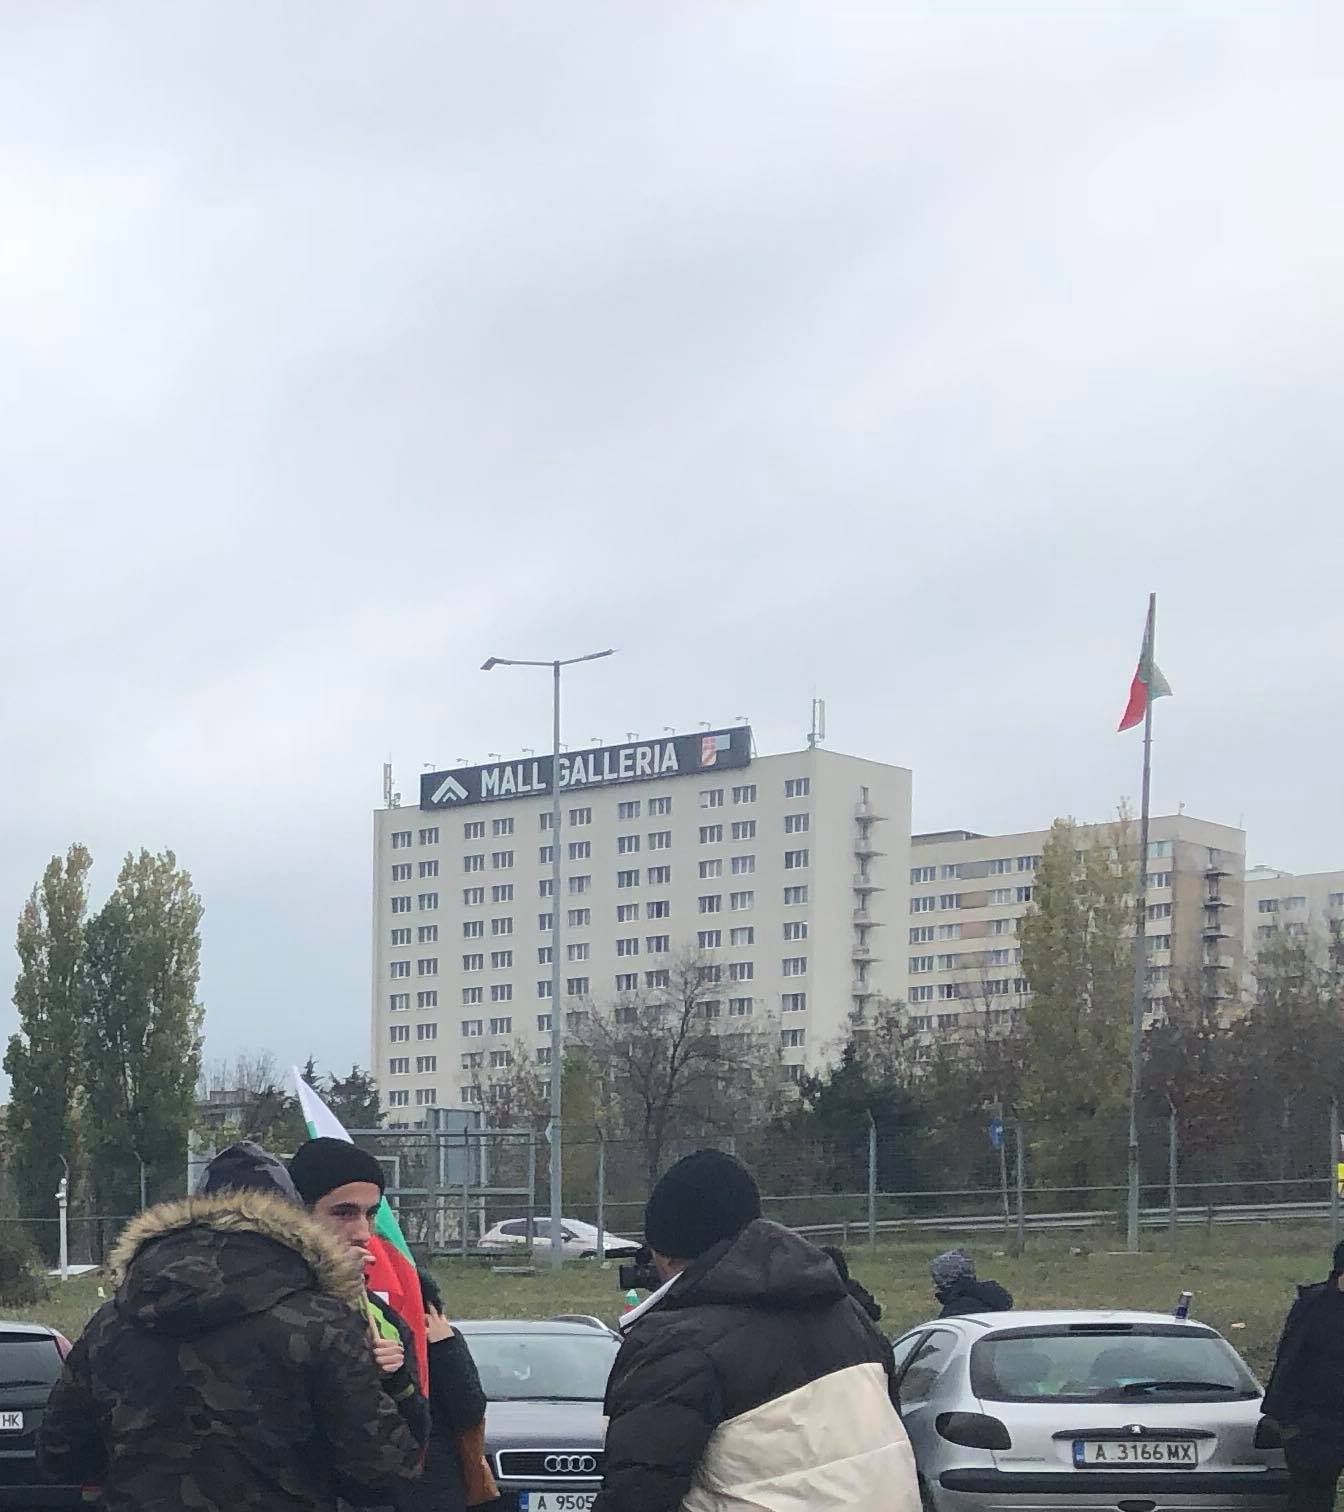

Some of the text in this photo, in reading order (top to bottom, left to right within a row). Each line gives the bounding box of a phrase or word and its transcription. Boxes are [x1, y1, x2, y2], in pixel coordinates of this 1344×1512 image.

[480, 742, 679, 798] MALL GALLERIA
[537, 1495, 595, 1510] A 9505
